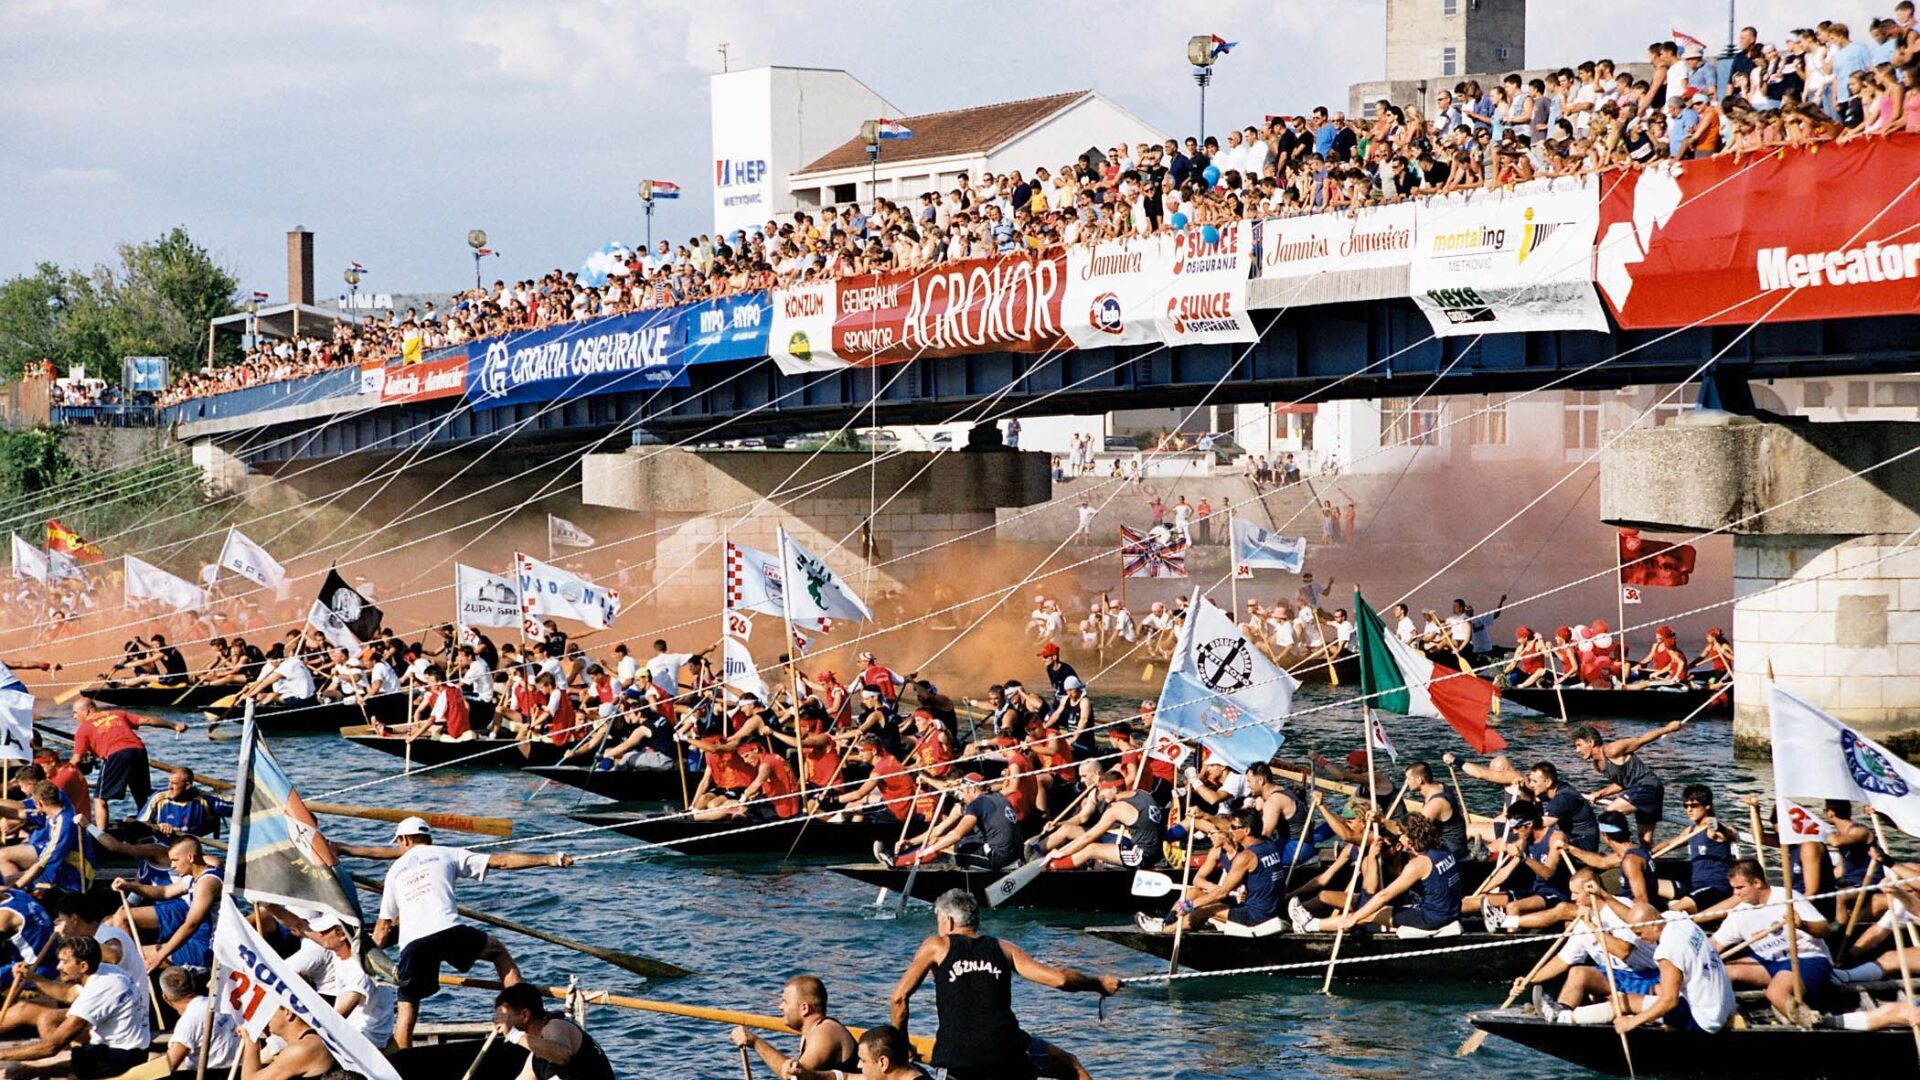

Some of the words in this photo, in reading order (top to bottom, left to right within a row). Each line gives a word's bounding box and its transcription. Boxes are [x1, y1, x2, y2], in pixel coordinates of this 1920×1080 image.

[735, 160, 767, 184] HEP
[1188, 227, 1238, 259] SUNCE
[1433, 224, 1505, 252] montaling
[1081, 246, 1142, 282] Jamnica
[1186, 257, 1237, 273] OSIGURANJE
[1757, 241, 1920, 291] Mercator
[349, 293, 394, 309] INA
[784, 293, 824, 320] KONZUM
[842, 284, 900, 314] GENERALNI
[902, 260, 1070, 350] AGROKOR
[1180, 292, 1232, 321] SUNCE
[700, 309, 725, 333] HYPO
[733, 303, 761, 329] HYPO
[511, 340, 567, 384] CROATIA
[570, 325, 671, 375] OSIGURANJE
[843, 327, 895, 353] SPONZOR
[523, 619, 540, 637] 23
[729, 615, 747, 635] 26
[1788, 806, 1821, 836] 32
[229, 970, 267, 1022] 21
